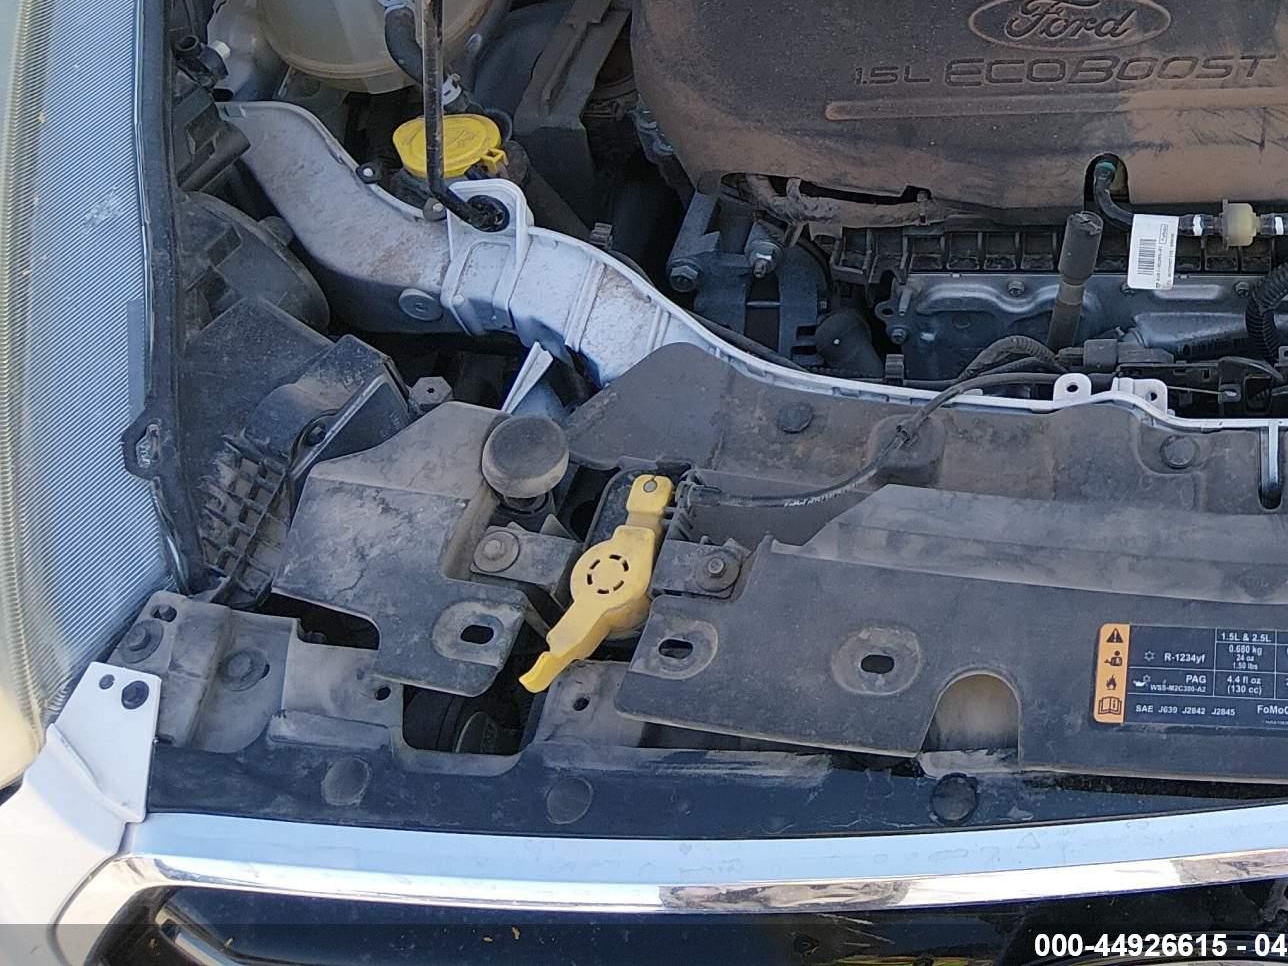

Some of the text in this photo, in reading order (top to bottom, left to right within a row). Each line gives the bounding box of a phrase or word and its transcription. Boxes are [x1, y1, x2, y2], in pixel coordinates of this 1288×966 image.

[855, 66, 930, 85] 1.5L
[1221, 633, 1271, 642] 1.5L & 2.5L
[1228, 644, 1263, 656] 0.680 kg
[1164, 652, 1205, 665] R-1234yf
[1236, 654, 1245, 662] 24
[1232, 662, 1258, 670] 1.50 lbs
[1185, 674, 1207, 684] PAG
[1226, 675, 1261, 685] 4.4 fl oz
[1227, 684, 1262, 696] (130 cc)
[1135, 704, 1236, 716] SAE J639 J2842 J2845
